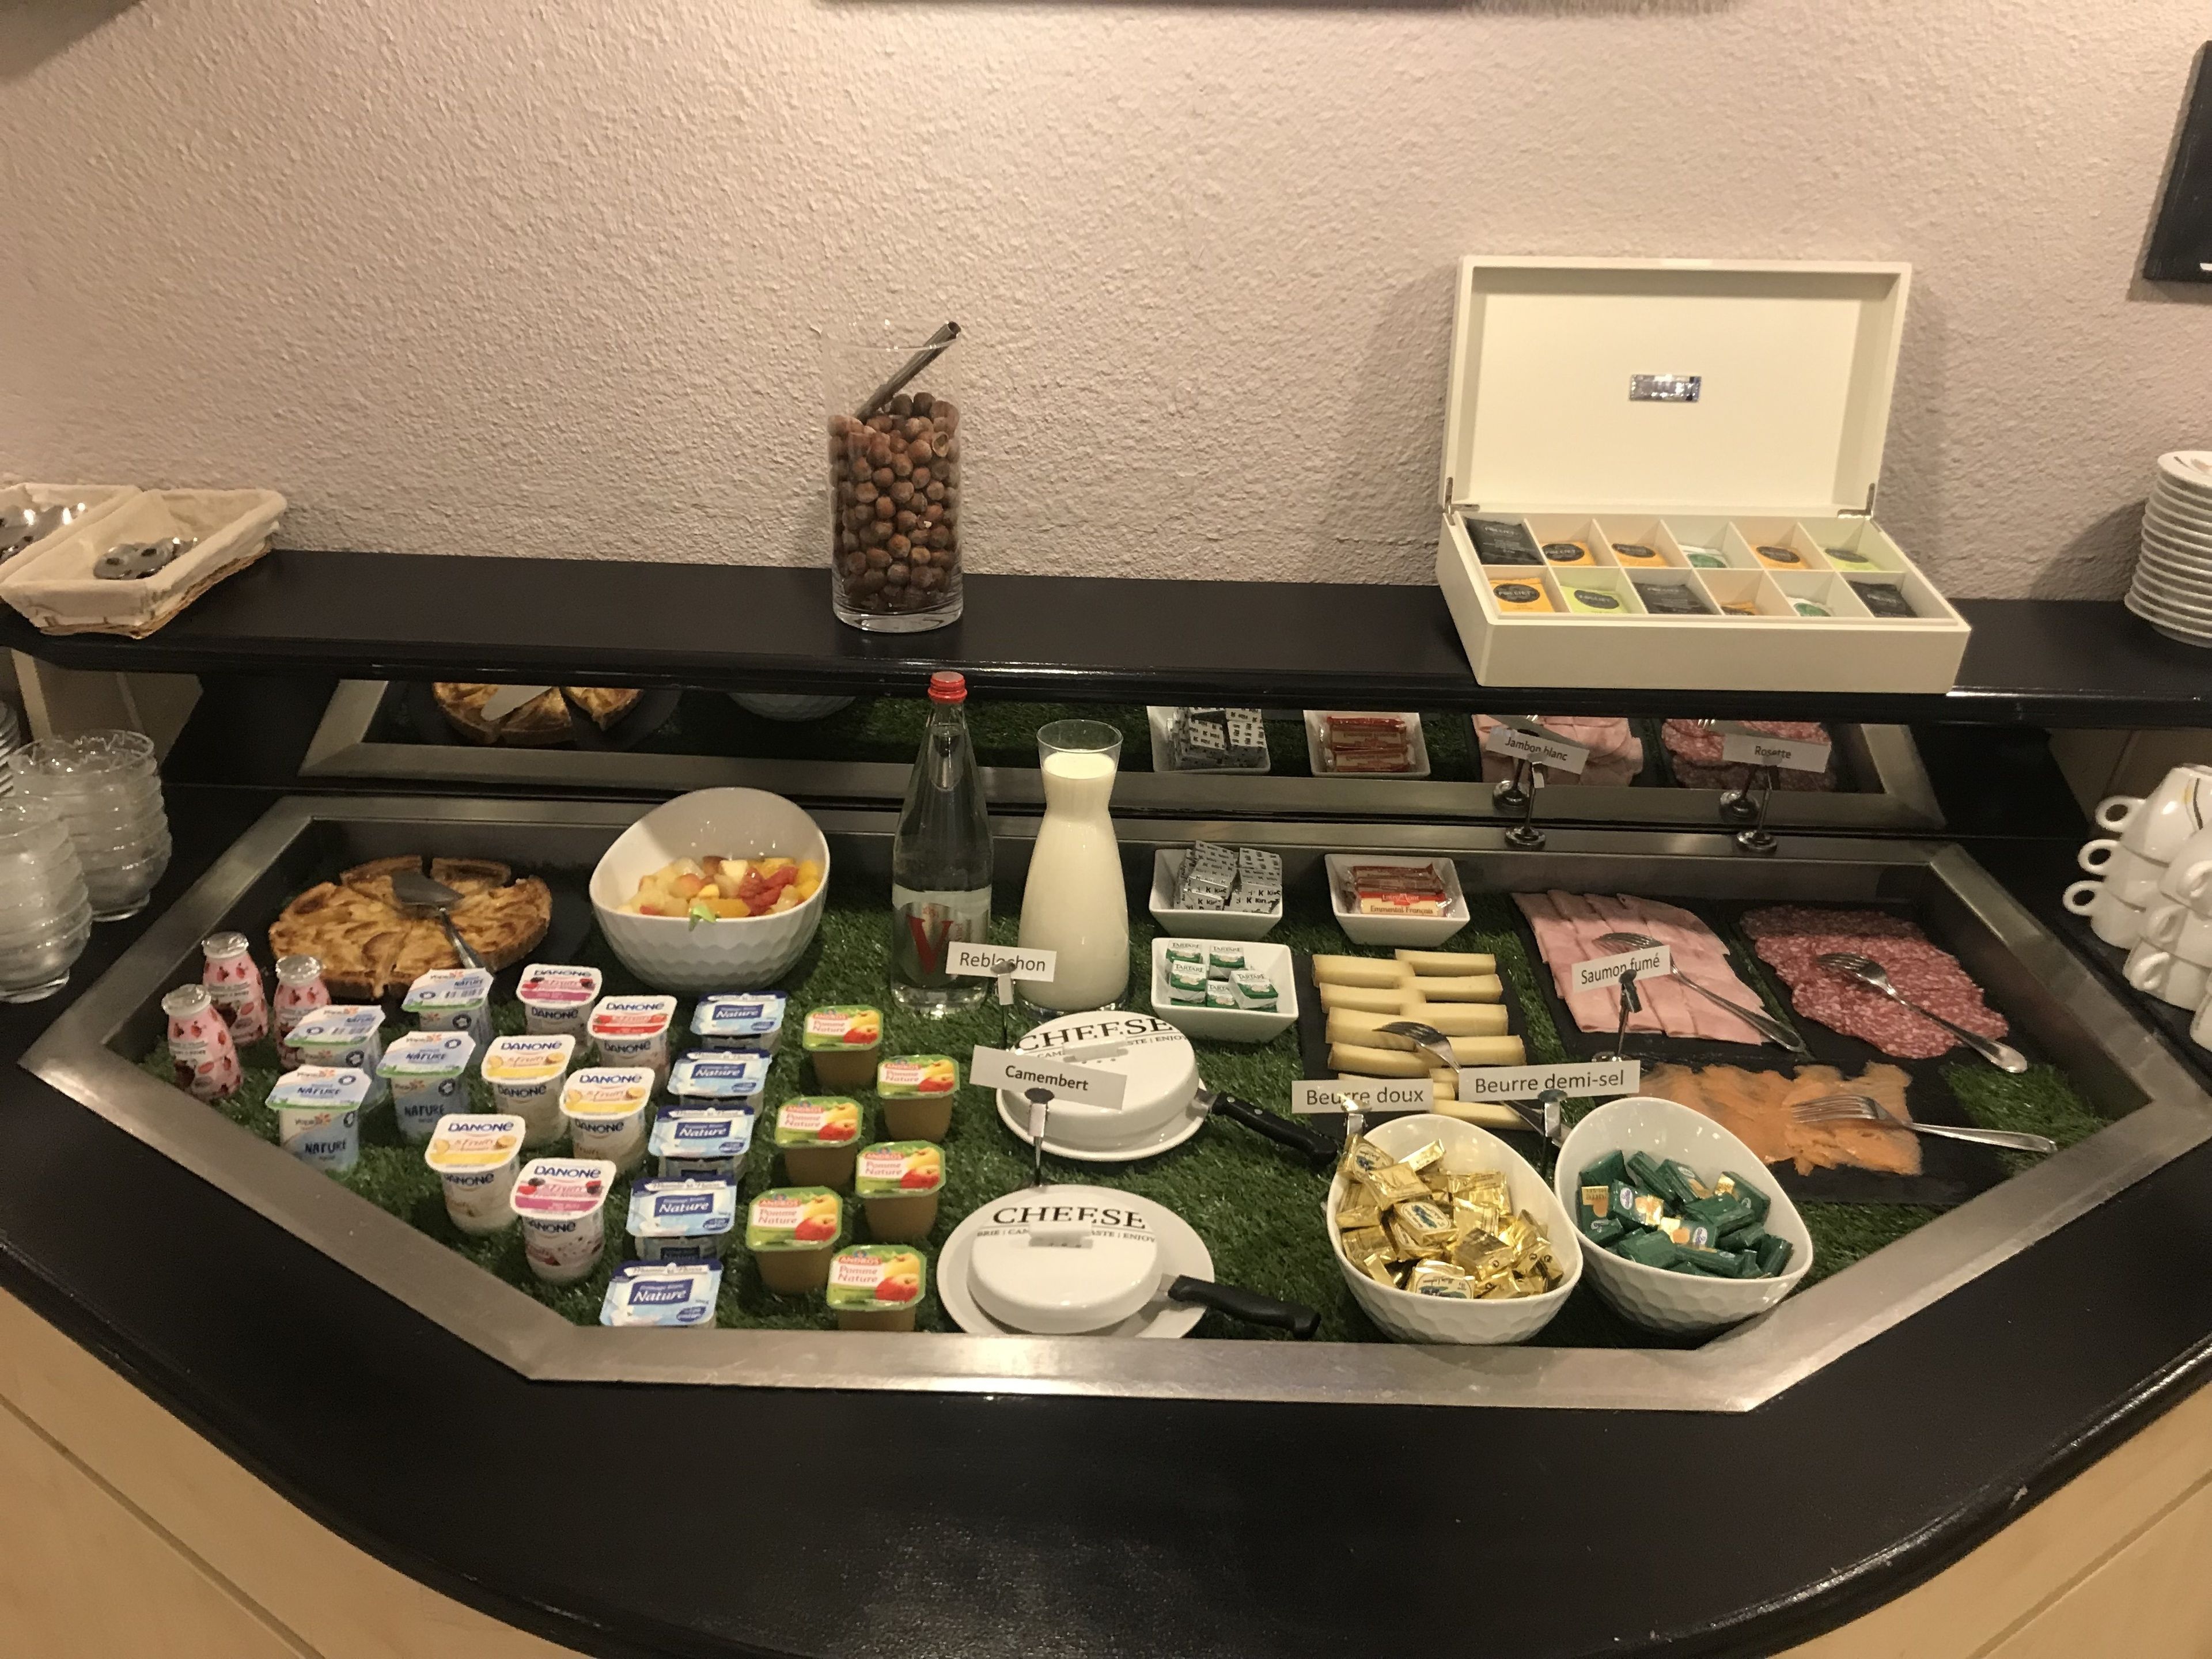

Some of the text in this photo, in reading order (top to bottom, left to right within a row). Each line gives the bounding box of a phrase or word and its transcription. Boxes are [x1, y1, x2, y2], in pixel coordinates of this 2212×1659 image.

[1505, 737, 1541, 753] Jambon
[1406, 906, 1433, 915] Français
[1176, 963, 1204, 972] TARTARE
[1581, 952, 1660, 984] Saumon fumé
[605, 1002, 664, 1011] DANONE
[532, 1007, 578, 1019] DANONE
[715, 1009, 759, 1018] Nature
[1016, 1018, 1173, 1051] CHEESE
[501, 1041, 562, 1050] DANONE
[405, 1052, 447, 1061] NATURE
[695, 1068, 741, 1078] Nature
[1005, 1065, 1089, 1091] Camembert
[579, 1074, 642, 1084] DANONE
[1475, 1070, 1624, 1093] Beurre demi-sel
[297, 1086, 342, 1095] NATURE
[497, 1084, 547, 1097] DANONE
[1377, 1086, 1424, 1103] doux
[404, 1103, 445, 1117] NATURE
[448, 1122, 514, 1132] DANONE
[576, 1120, 624, 1133] DANONE
[679, 1127, 727, 1137] Nature
[304, 1137, 347, 1155] NATURE
[534, 1165, 601, 1179] DANONE
[865, 1168, 902, 1176] Nature
[659, 1202, 710, 1213] Nature
[760, 1209, 797, 1217] Pomme
[993, 1206, 1146, 1229] CHEESE
[758, 1216, 797, 1225] Nature
[839, 1266, 877, 1275] Pomme
[838, 1274, 878, 1283] Nature
[633, 1289, 687, 1302] Nature
